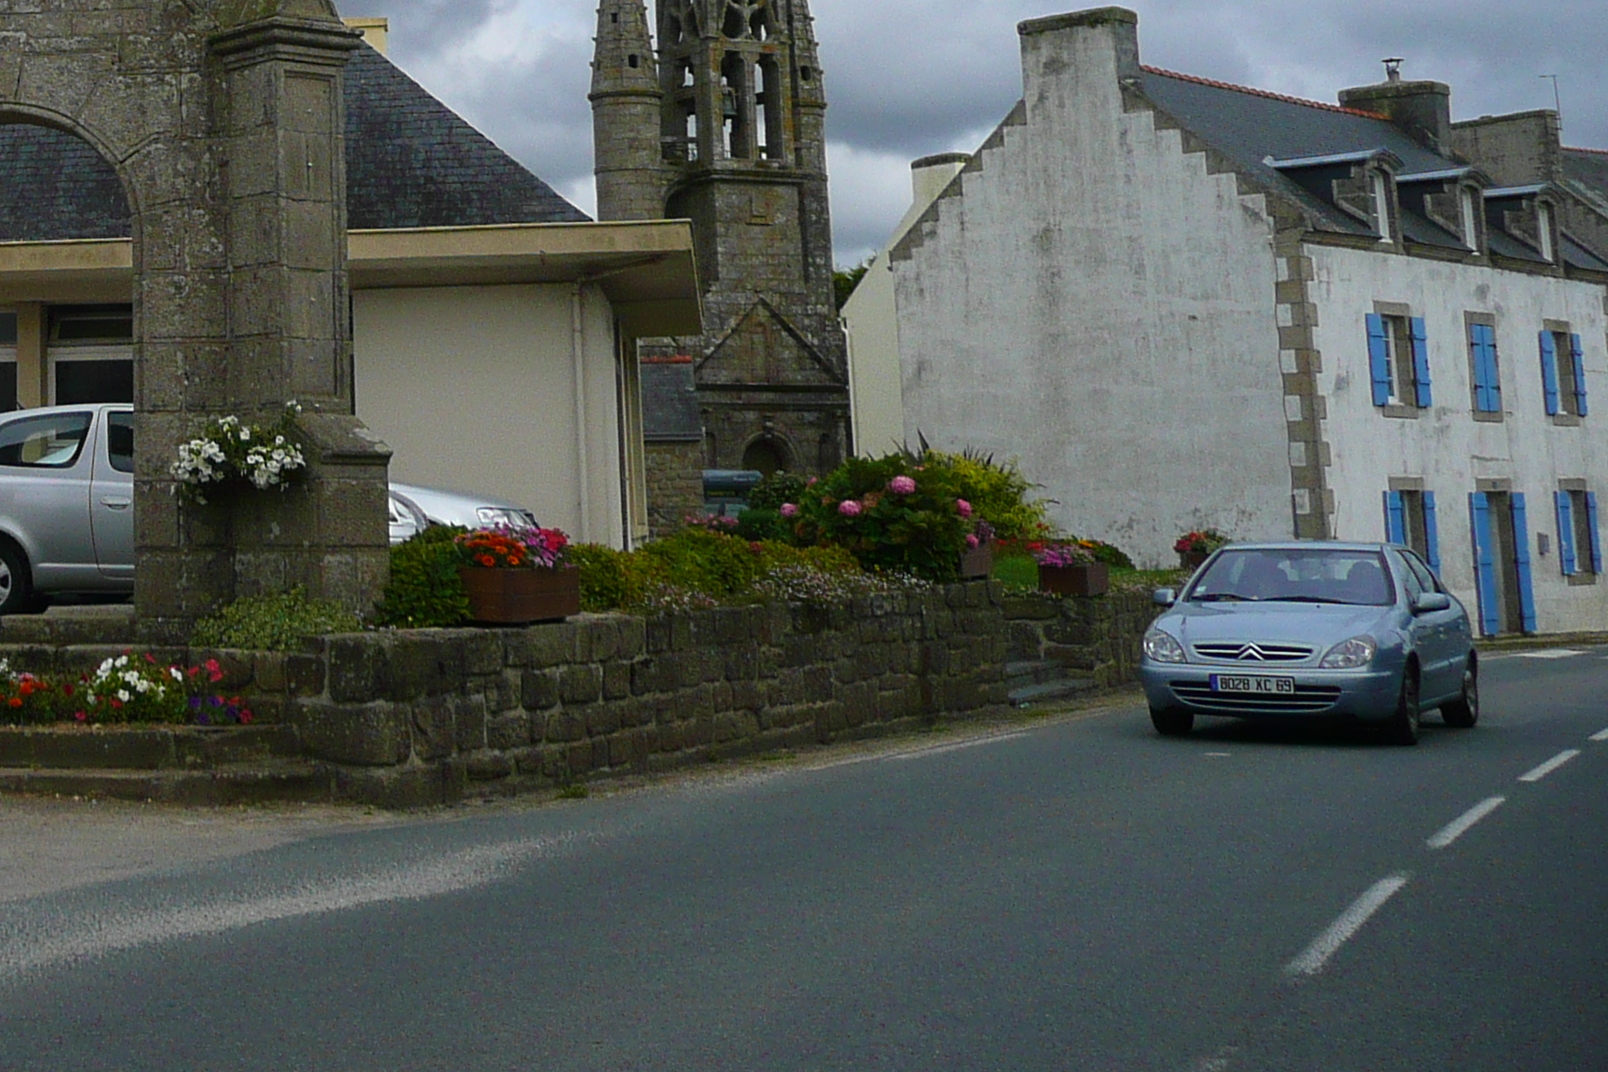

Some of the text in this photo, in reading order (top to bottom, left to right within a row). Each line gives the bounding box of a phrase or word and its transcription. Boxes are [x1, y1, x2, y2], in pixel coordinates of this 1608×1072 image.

[1220, 677, 1292, 692] 8028 XC 69
